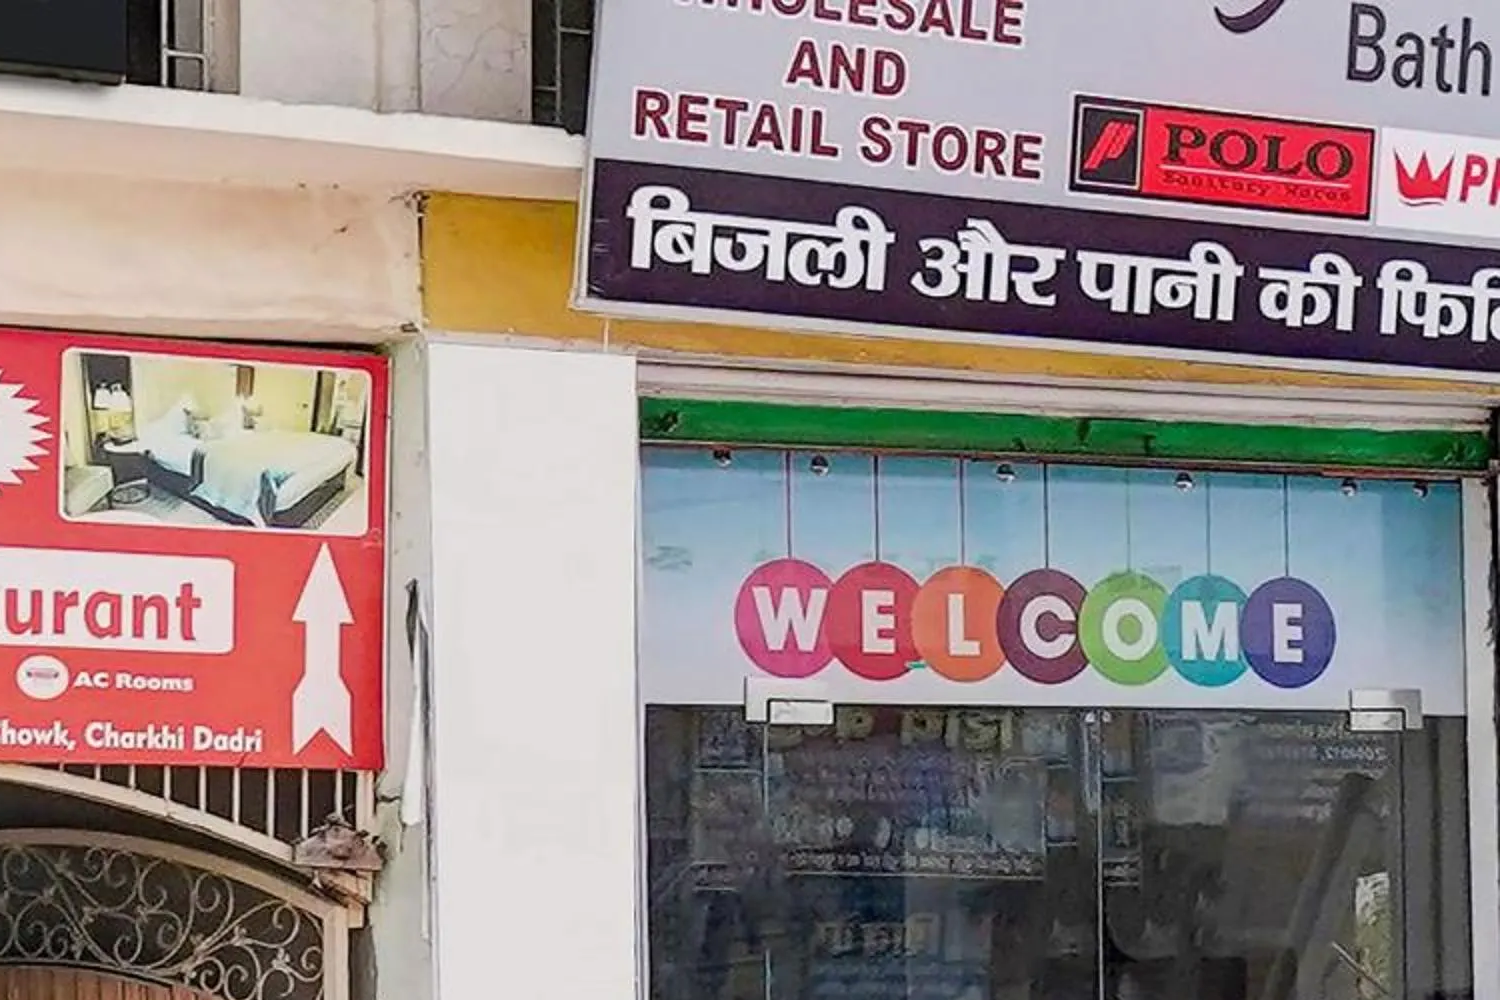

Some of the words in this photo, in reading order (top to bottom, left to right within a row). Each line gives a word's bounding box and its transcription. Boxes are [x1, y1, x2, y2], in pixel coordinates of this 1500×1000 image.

[669, 0, 1024, 45] ESALE
[1347, 2, 1492, 97] Bath
[786, 39, 908, 95] AND
[634, 89, 839, 158] RETAIL
[861, 116, 1043, 179] STORE
[1162, 122, 1354, 182] POLO
[1459, 152, 1500, 206] P
[626, 185, 896, 292] बिजली
[910, 217, 1067, 307] और
[1075, 241, 1245, 322] पानी
[1258, 252, 1363, 332] की
[751, 584, 1304, 665] WELCOME
[72, 670, 110, 689] AC
[115, 672, 195, 692] Rooms
[84, 721, 185, 751] Charkhi
[193, 726, 263, 754] Dadri
